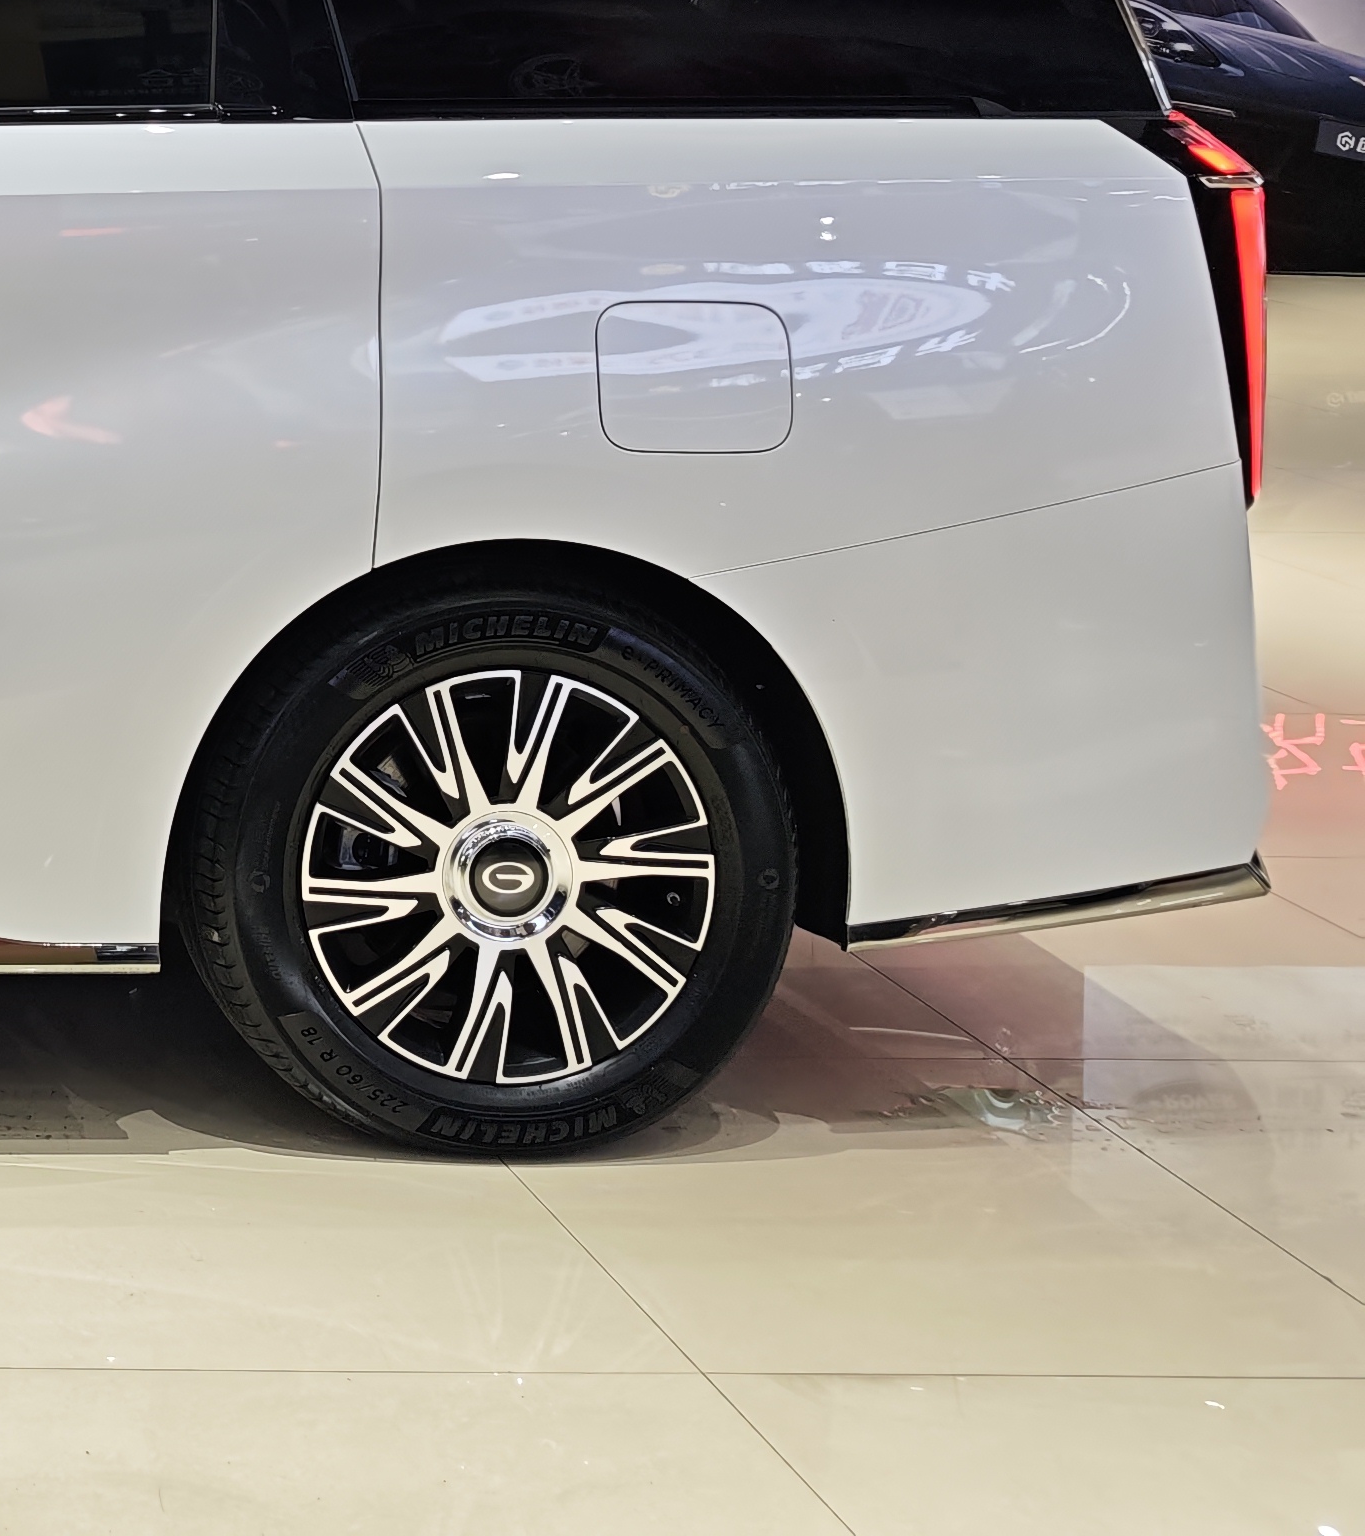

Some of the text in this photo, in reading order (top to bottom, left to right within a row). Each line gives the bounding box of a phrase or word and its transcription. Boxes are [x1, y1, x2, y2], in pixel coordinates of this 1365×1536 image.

[415, 614, 600, 656] MICHELIN
[300, 1028, 320, 1046] 18
[319, 1048, 336, 1063] R
[431, 1106, 619, 1146] MICHELIN
